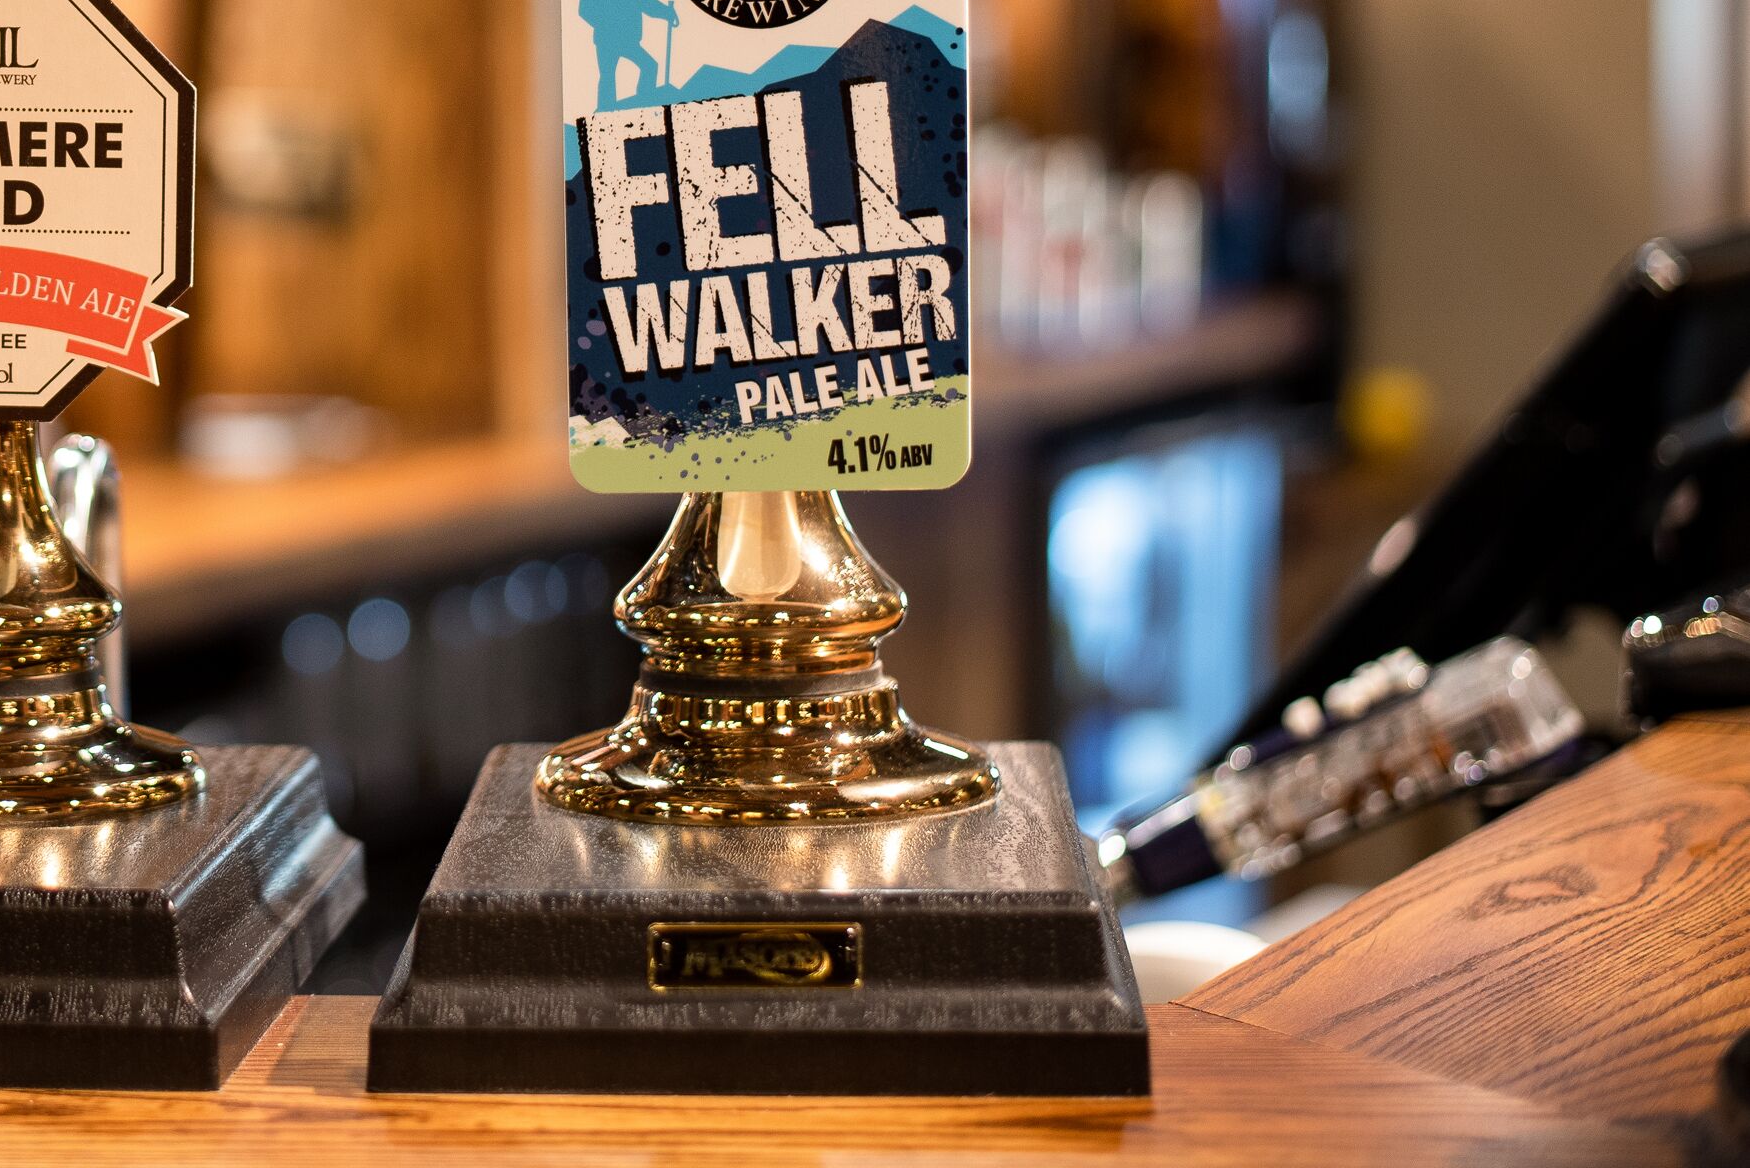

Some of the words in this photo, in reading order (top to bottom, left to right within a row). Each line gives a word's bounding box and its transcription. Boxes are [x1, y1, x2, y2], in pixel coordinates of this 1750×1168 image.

[579, 78, 947, 280] FELL
[79, 287, 136, 324] ALE
[601, 254, 956, 373] WALKER
[734, 363, 844, 424] PALE
[857, 348, 936, 403] ALE
[827, 434, 896, 474] 4.1%
[900, 443, 933, 468] ABV
